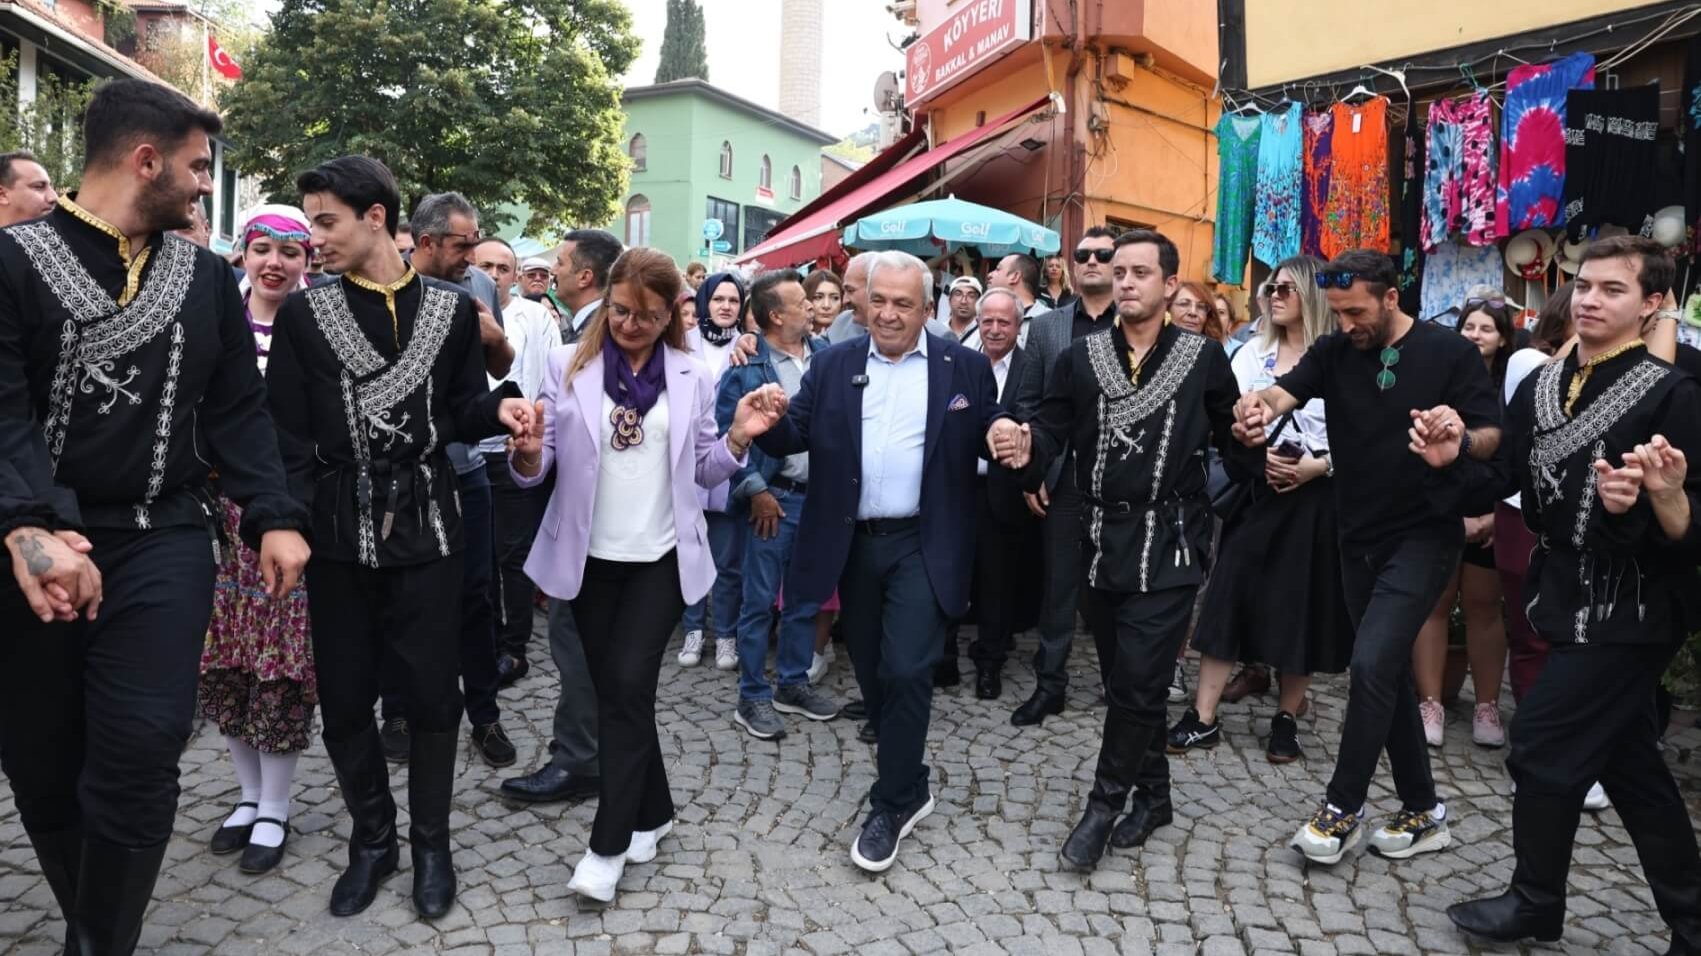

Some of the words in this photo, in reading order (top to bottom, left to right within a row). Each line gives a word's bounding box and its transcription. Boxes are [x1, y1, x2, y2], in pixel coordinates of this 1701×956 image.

[935, 51, 967, 82] BAKKAL
[968, 46, 976, 61] &
[977, 22, 1010, 56] MANAV
